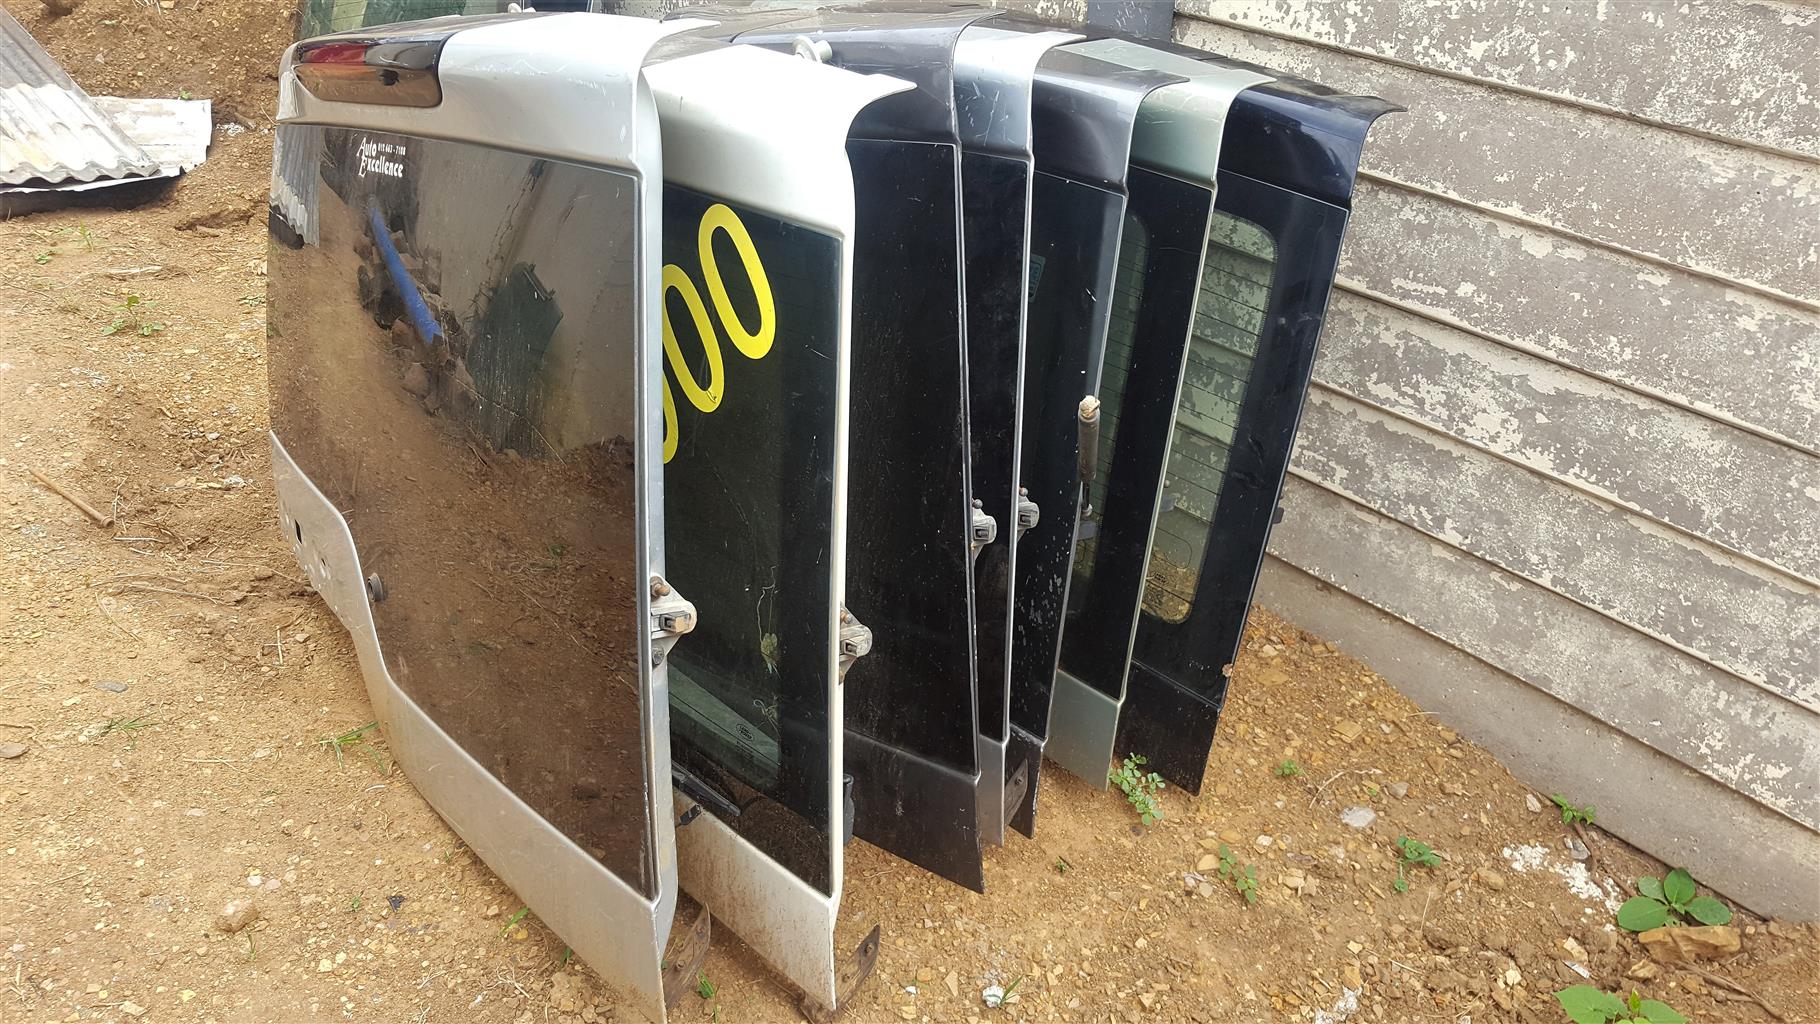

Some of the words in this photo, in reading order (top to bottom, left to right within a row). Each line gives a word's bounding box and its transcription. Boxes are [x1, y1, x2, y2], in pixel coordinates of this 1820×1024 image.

[356, 137, 377, 157] Auto
[358, 155, 404, 178] Excellence
[663, 203, 777, 465] 00
